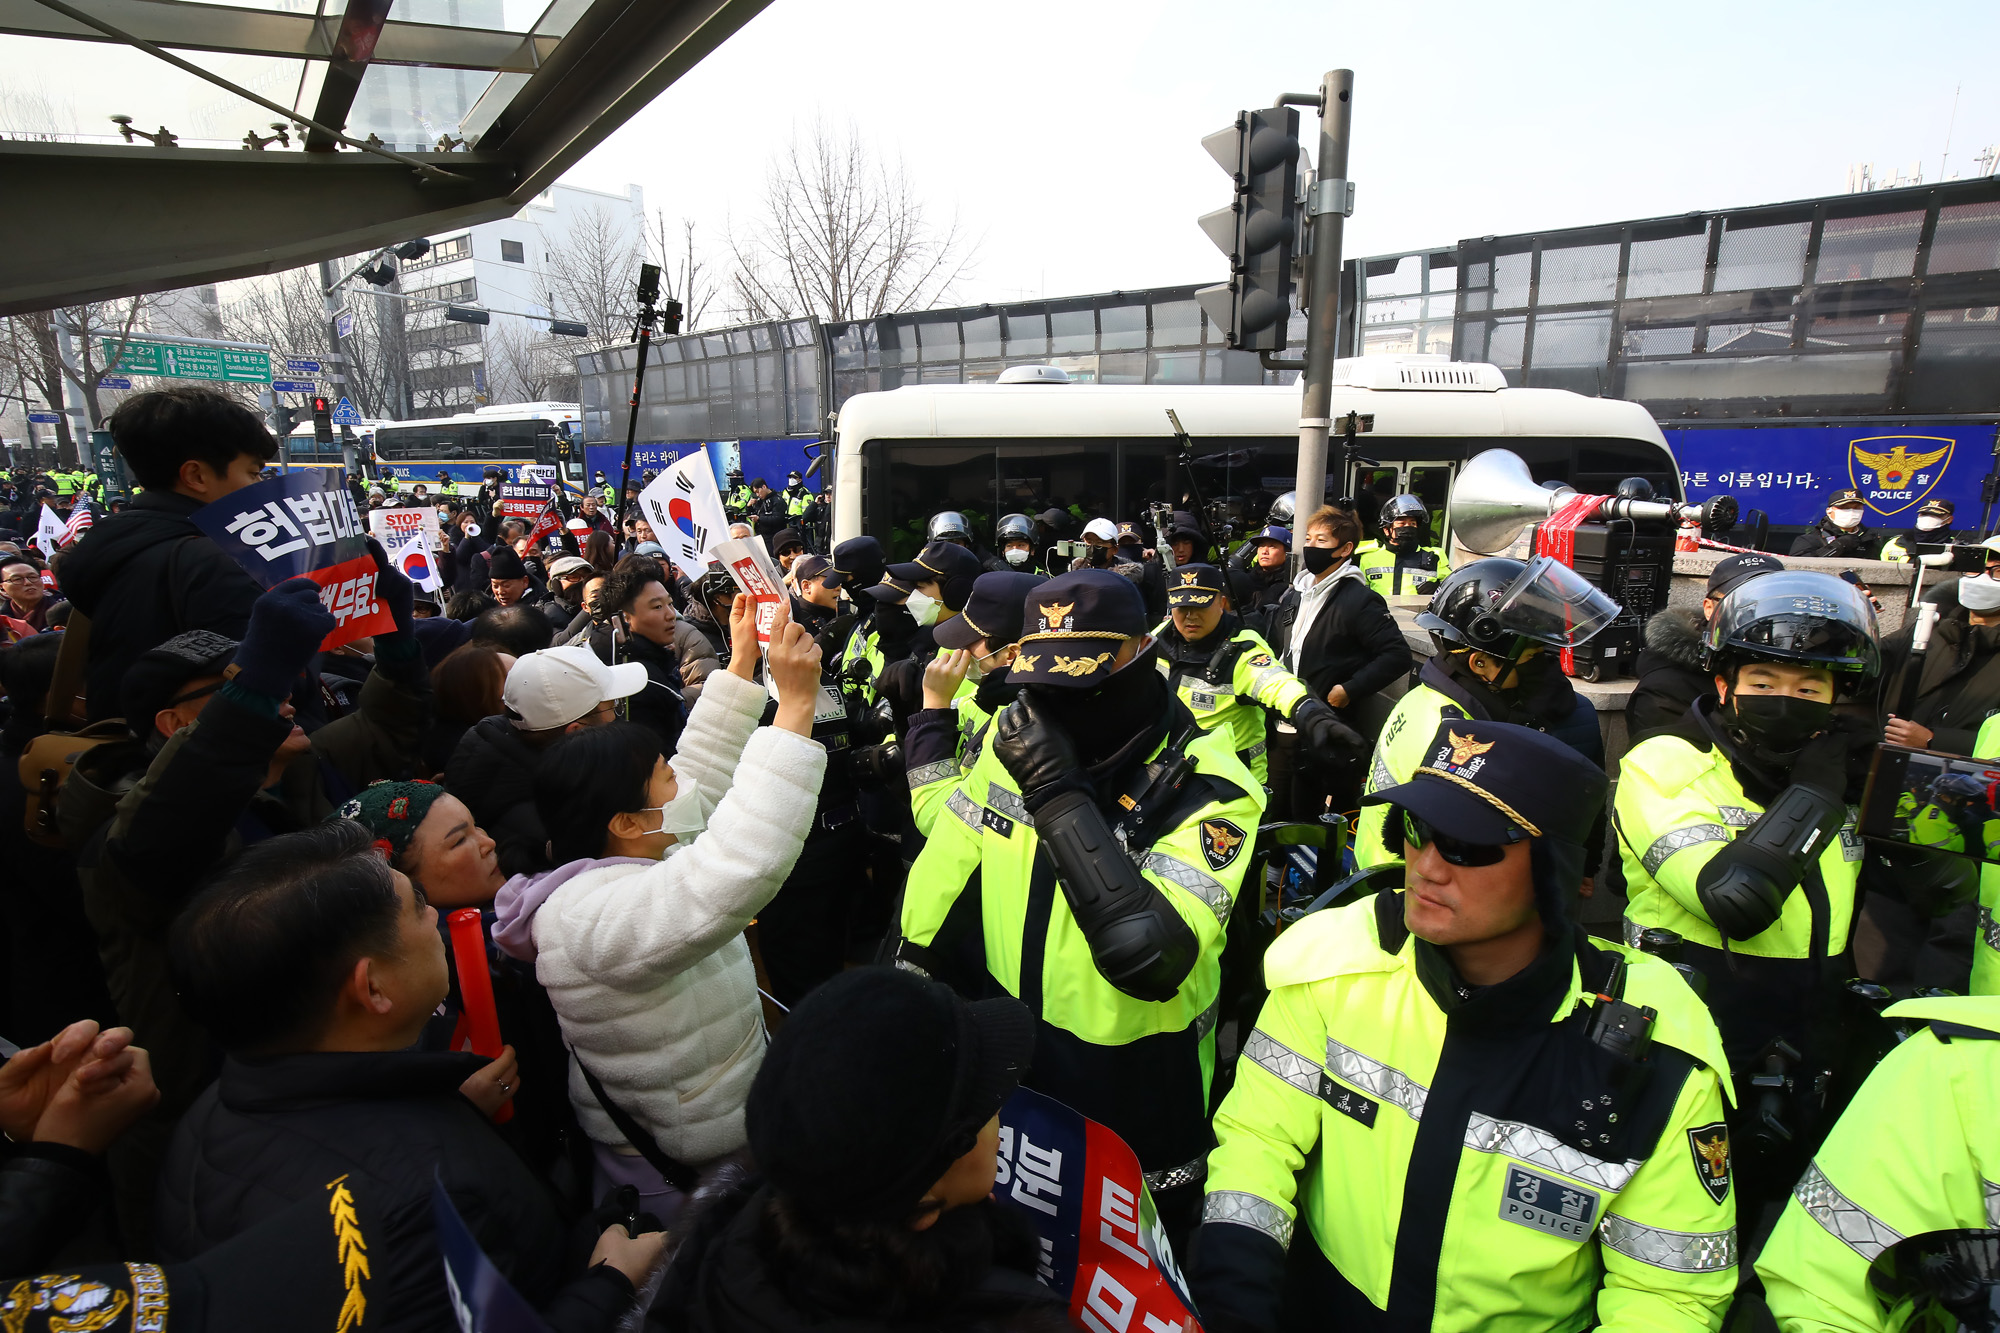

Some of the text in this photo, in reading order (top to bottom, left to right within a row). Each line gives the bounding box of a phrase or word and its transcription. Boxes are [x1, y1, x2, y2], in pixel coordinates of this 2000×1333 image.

[223, 353, 267, 365] 헌법재판소
[225, 364, 268, 373] Constitutional Court
[634, 451, 657, 467] 폴리스
[393, 467, 411, 478] POLICE
[1860, 473, 1930, 485] 경 찰
[1717, 470, 1820, 490] 이름입니다.
[502, 485, 549, 498] 헌법대로!
[1869, 490, 1913, 501] POLICE
[385, 513, 423, 526] STOP
[392, 524, 419, 537] THE
[1192, 701, 1214, 710] POLICE
[1437, 746, 1487, 773] 경 찰
[1208, 849, 1227, 863] POLICE
[1709, 1176, 1729, 1188] POLICE
[1508, 1203, 1584, 1236] POLICE
